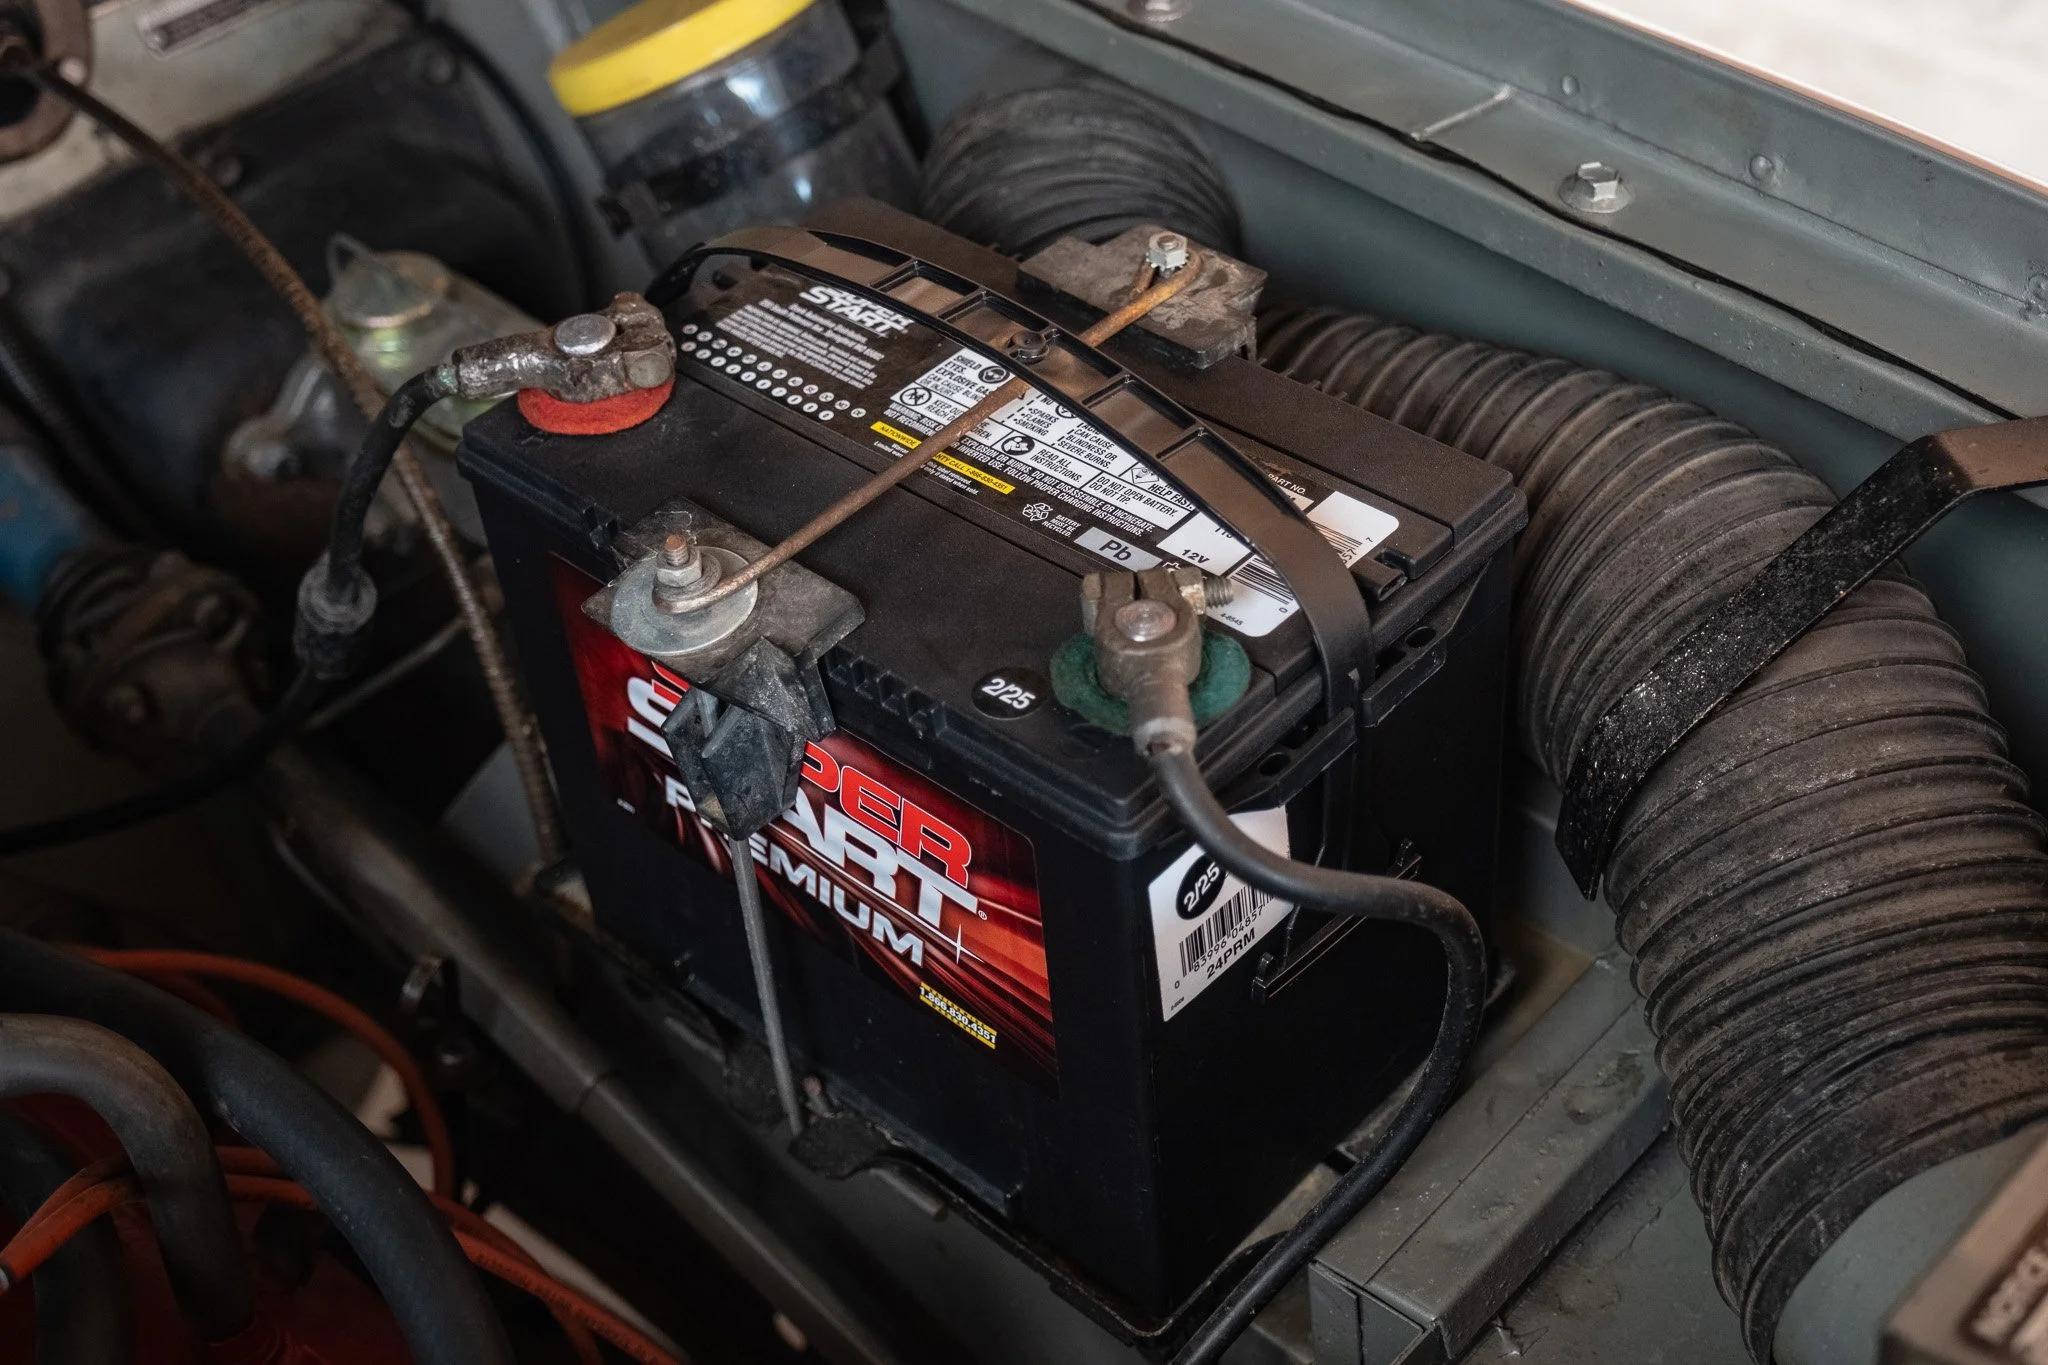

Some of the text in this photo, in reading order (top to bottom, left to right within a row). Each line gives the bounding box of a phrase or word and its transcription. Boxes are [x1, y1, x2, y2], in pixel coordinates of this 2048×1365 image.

[799, 286, 904, 332] START
[953, 354, 982, 370] SHIELD
[926, 373, 942, 382] CAN
[940, 379, 964, 392] CAUSE
[935, 367, 978, 389] EXPLOSIVE
[924, 404, 950, 418] REACH
[931, 399, 952, 411] KEEP
[881, 426, 917, 446] NATIONWIDE
[947, 459, 966, 470] CALL
[1065, 434, 1118, 461] BLINDNESS OR
[1073, 428, 1115, 449] CAN CAUSE
[1036, 448, 1073, 467] READ ALL
[1057, 440, 1113, 468] SEVERE BURNS.
[881, 408, 900, 419] NOT
[956, 444, 991, 463] INVERTED
[986, 459, 1006, 470] USE.
[1002, 466, 1034, 483] FOLLOW
[1029, 479, 1060, 496] PROPER
[1056, 492, 1095, 512] CHARGING
[1090, 508, 1147, 537] INSTRUCTIONS.
[1028, 454, 1084, 482] INSTRUCTIONS.
[959, 437, 1000, 458] EXPLOSION
[995, 453, 1010, 462] OR
[1004, 458, 1034, 474] BURNS.
[1029, 470, 1046, 479] DO
[1040, 475, 1059, 486] NOT
[1055, 482, 1105, 507] DISASSEMBLE
[1100, 503, 1116, 513] OR
[1111, 509, 1158, 532] INCINERATE.
[1087, 482, 1133, 504] DO NOT TIP.
[1148, 484, 1173, 496] HELP
[1291, 483, 1306, 495] NO.
[1095, 476, 1179, 517] DO NOT OPEN BATTERY.
[1041, 520, 1073, 537] RECYCLED.
[1049, 518, 1067, 527] MUST
[1054, 514, 1081, 528] BATTERY
[1098, 539, 1132, 561] Pb
[1181, 548, 1210, 564] 12V
[982, 678, 1036, 709] 2/25
[665, 775, 925, 967] PEMIUM
[1184, 862, 1220, 912] 2/25
[1193, 938, 1227, 973] 83996
[1231, 904, 1264, 939] 04857
[1207, 927, 1256, 979] 24PRM
[919, 986, 997, 1044] 1.866.830.4351
